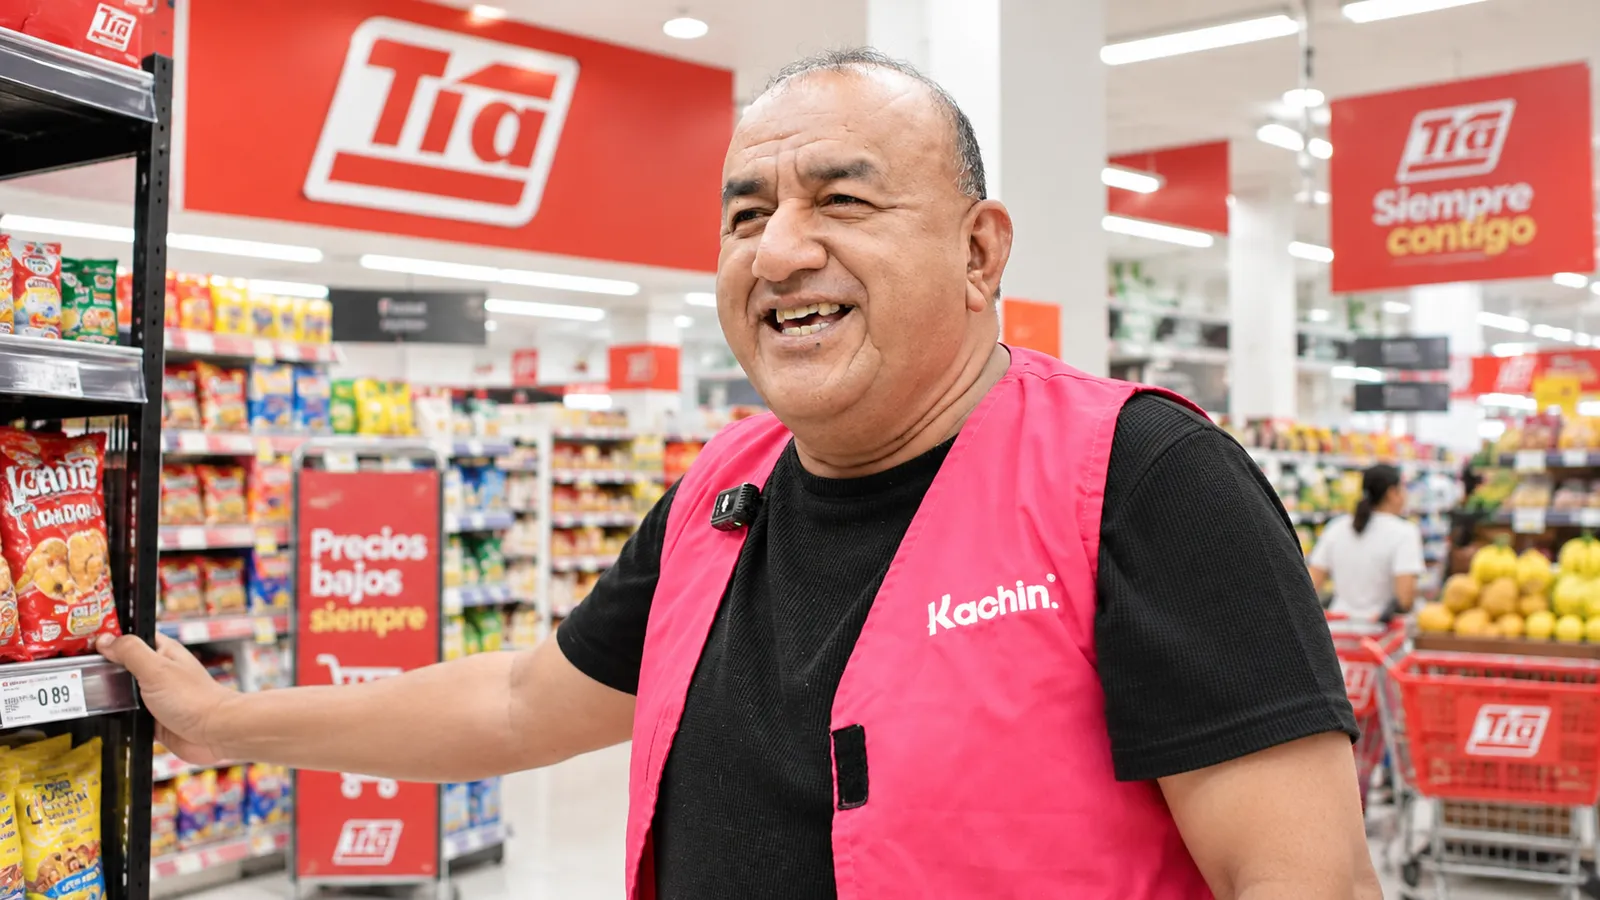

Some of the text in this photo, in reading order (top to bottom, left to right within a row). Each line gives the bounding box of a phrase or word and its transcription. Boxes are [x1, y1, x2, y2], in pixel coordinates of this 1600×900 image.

[1372, 182, 1534, 227] Siempre
[1387, 214, 1537, 256] contigo
[310, 525, 428, 562] Precios
[310, 560, 403, 605] bajos
[309, 600, 428, 639] siempre
